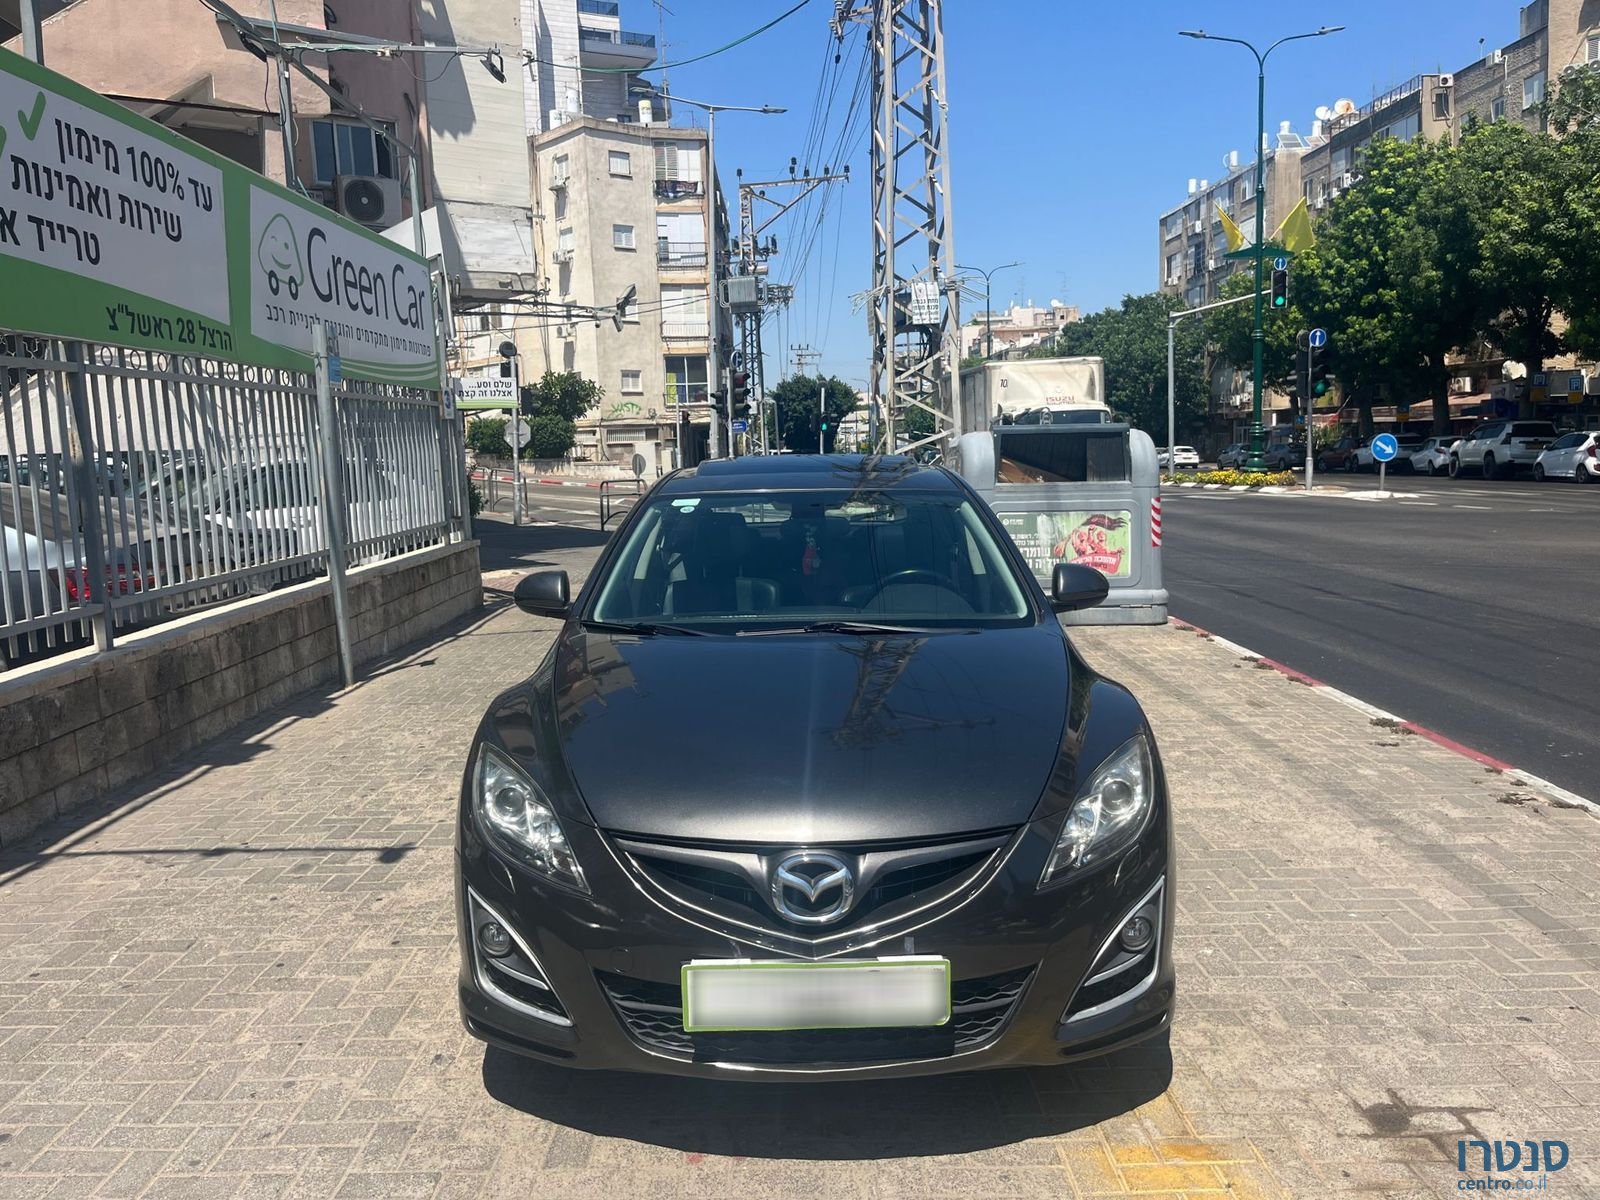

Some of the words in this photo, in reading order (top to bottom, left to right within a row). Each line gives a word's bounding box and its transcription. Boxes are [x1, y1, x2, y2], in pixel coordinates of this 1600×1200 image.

[54, 118, 120, 175] מימון
[10, 153, 112, 220] ואמינות
[127, 146, 185, 200] 100%
[188, 177, 213, 212] עד
[118, 192, 183, 243] שירות
[27, 214, 101, 266] טרייד
[307, 227, 389, 321] Green
[392, 263, 425, 331] Car
[176, 317, 196, 345] 28
[265, 304, 286, 323] רכב
[198, 320, 233, 352] הרצל
[457, 390, 476, 399] קצת
[490, 388, 513, 397] אצלנו
[493, 380, 512, 388] שלם
